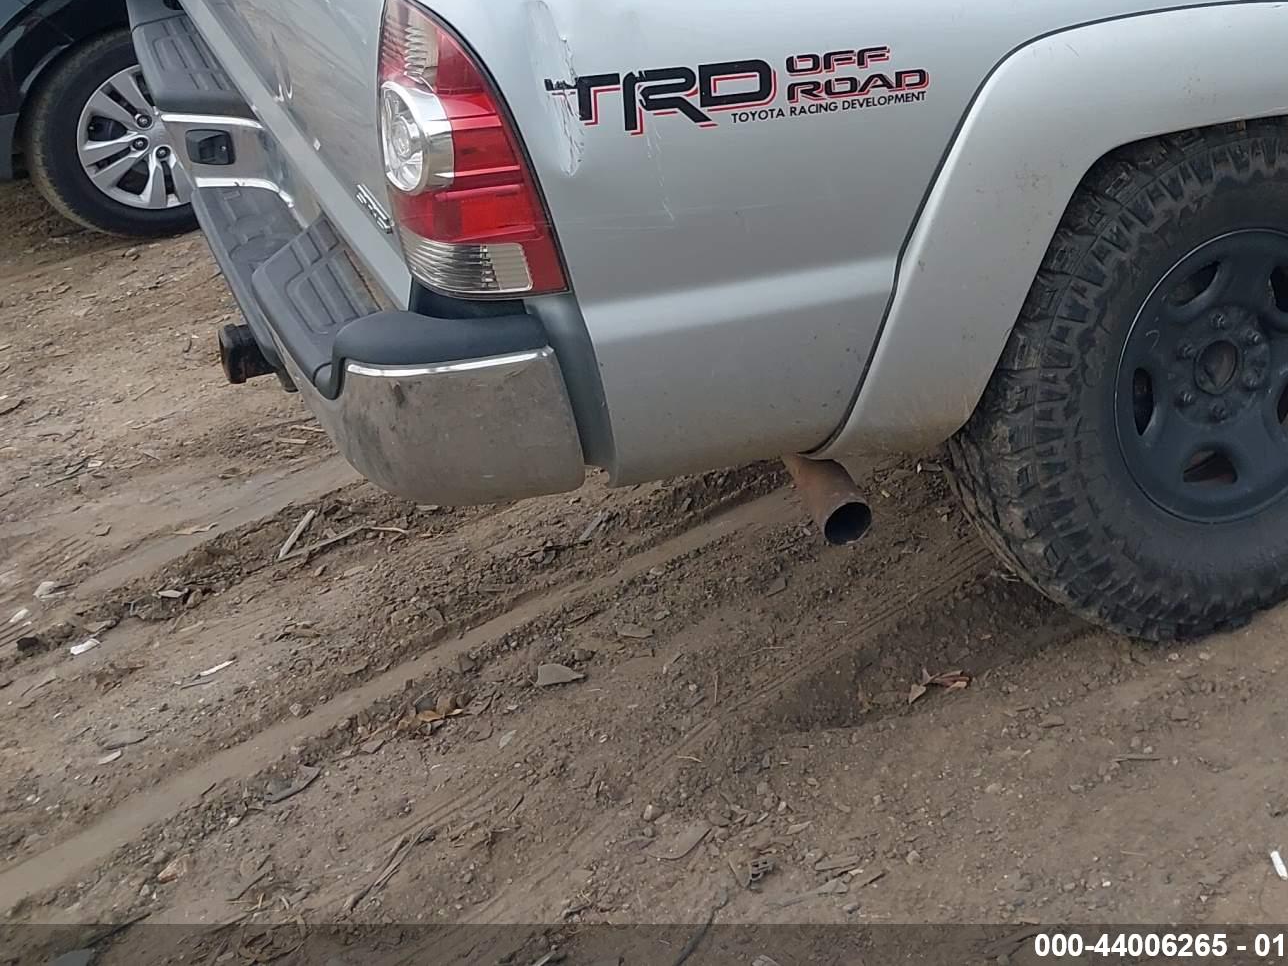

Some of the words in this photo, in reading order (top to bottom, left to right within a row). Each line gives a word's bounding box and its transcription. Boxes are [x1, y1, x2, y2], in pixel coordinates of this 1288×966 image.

[785, 46, 891, 76] OFF
[544, 59, 777, 135] TRD
[786, 69, 930, 104] ROAD
[731, 108, 786, 124] TOYOTA
[789, 100, 839, 118] RACING
[842, 90, 927, 111] DEVELOPMENT
